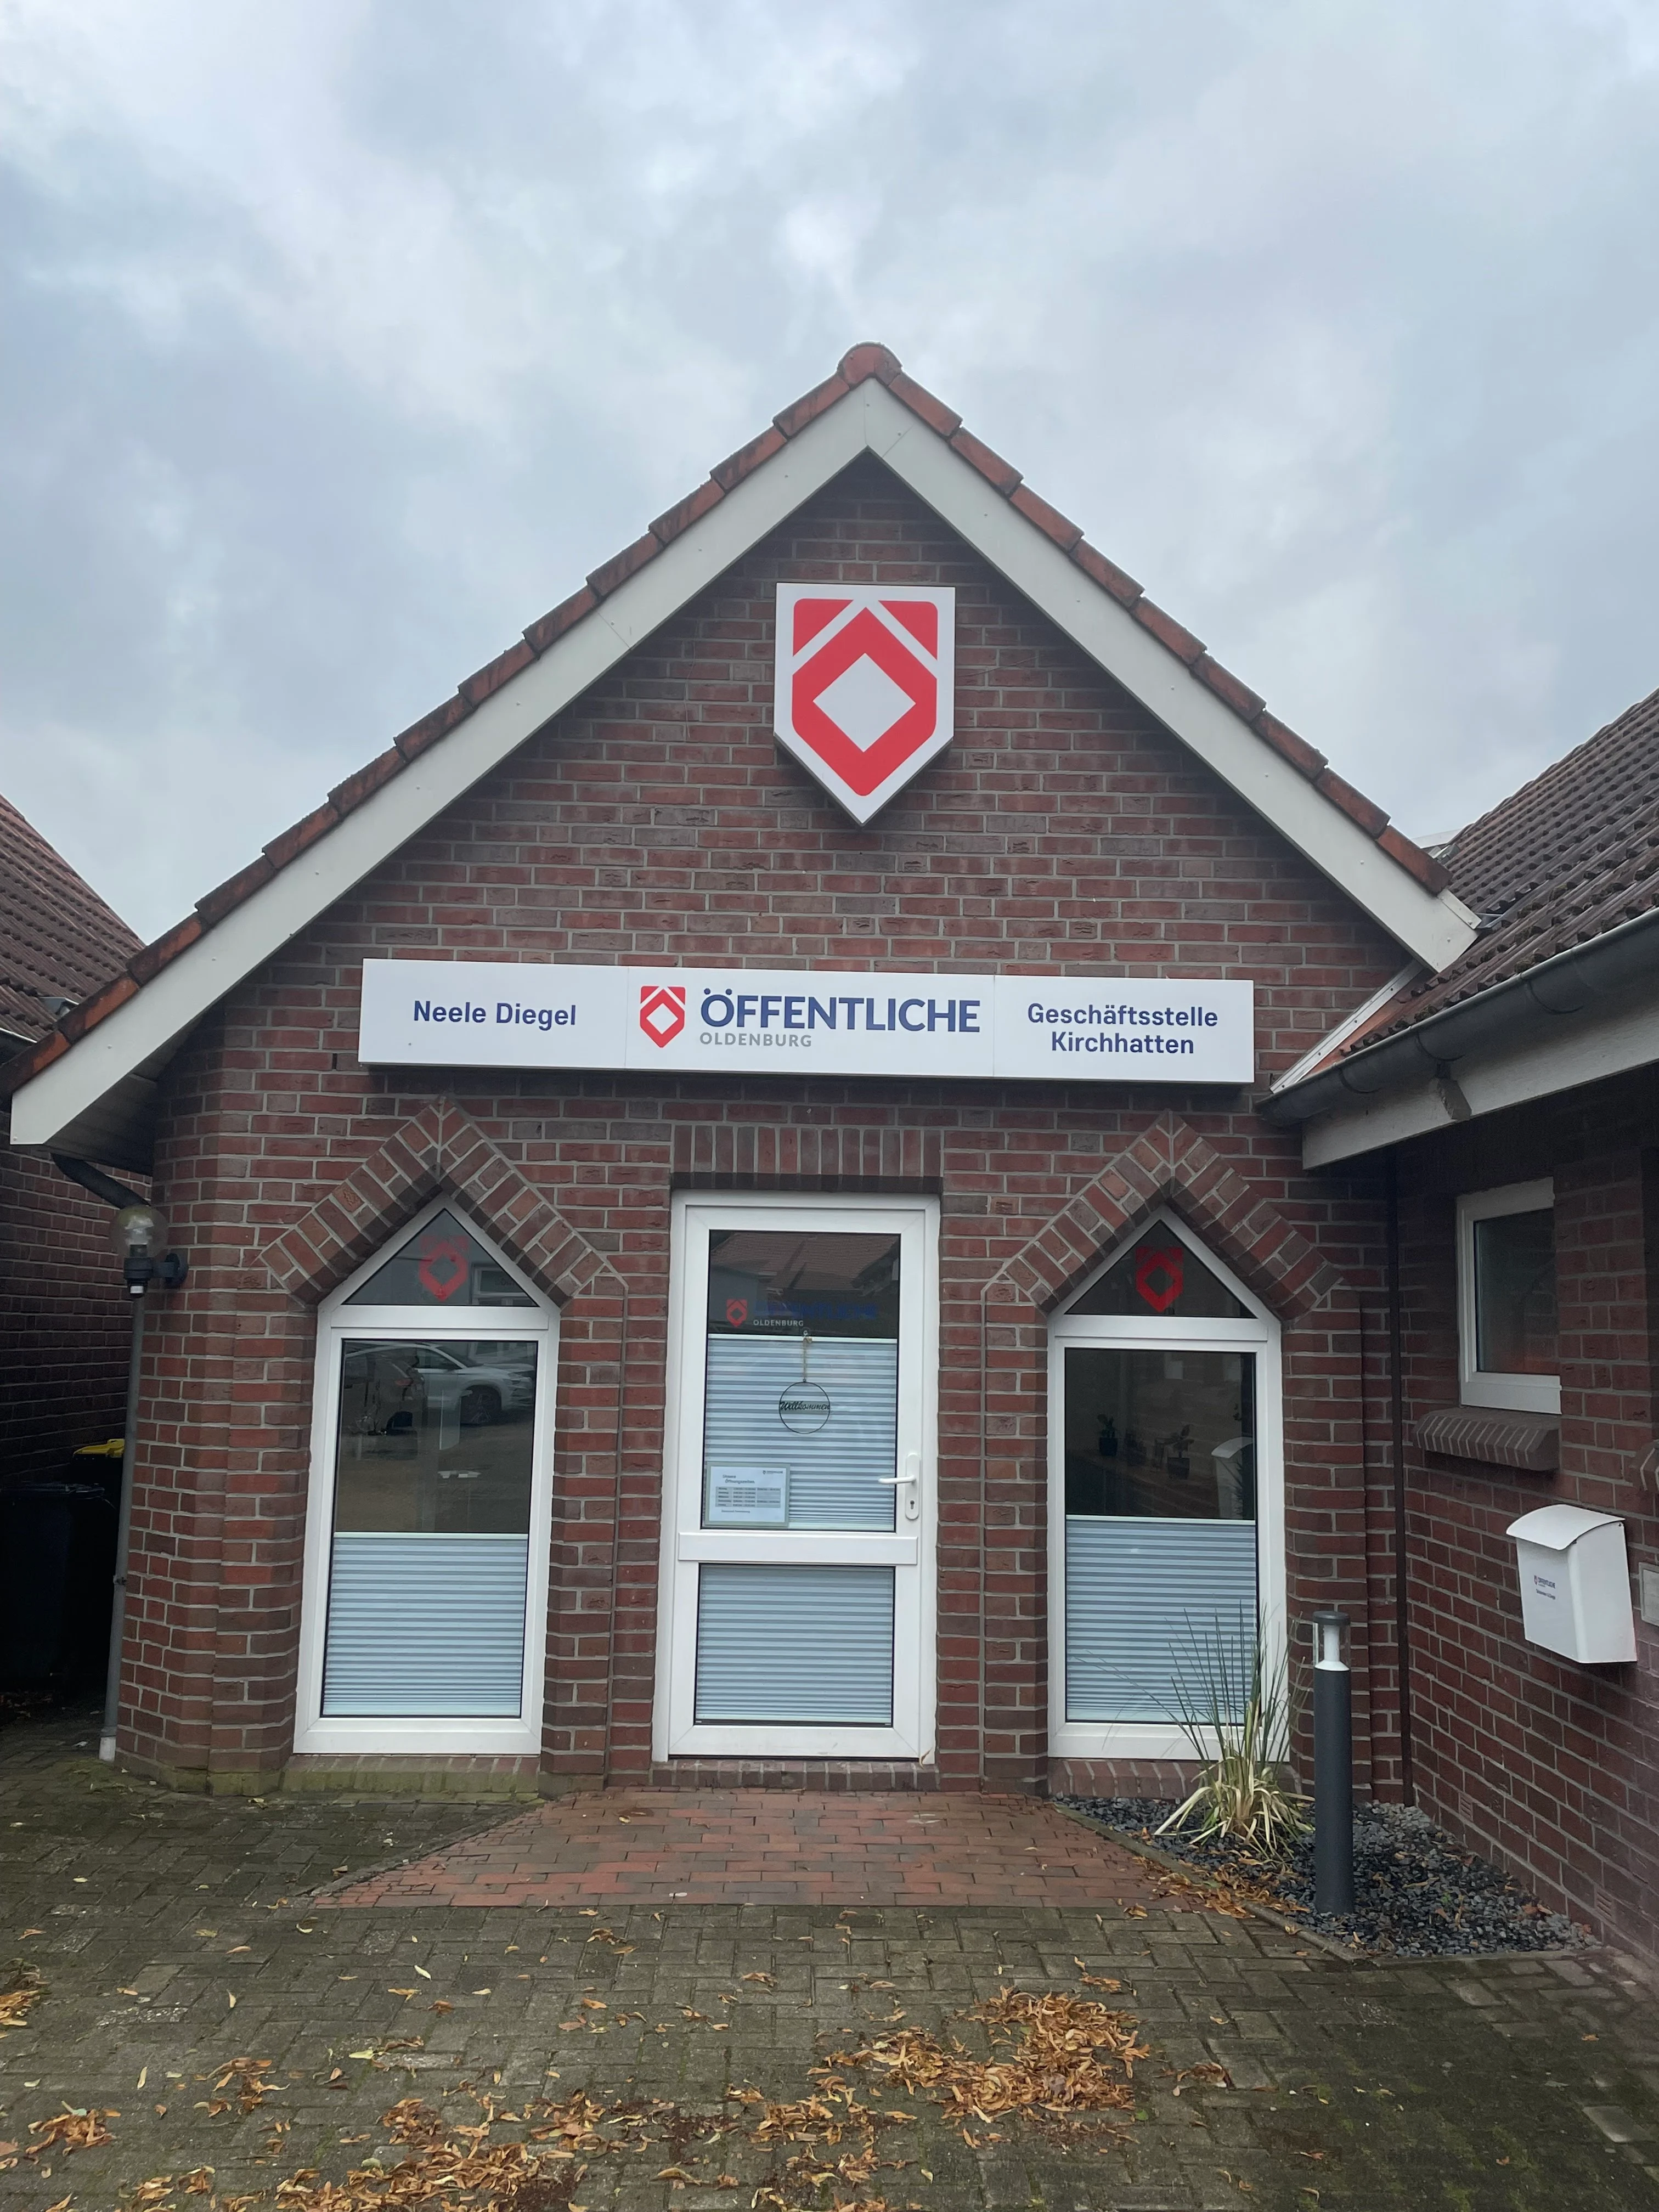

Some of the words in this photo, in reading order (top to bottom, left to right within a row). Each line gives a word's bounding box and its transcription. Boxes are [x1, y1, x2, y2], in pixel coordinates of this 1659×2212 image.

[414, 1000, 486, 1023] Neele
[496, 1003, 576, 1031] Diegel
[701, 988, 980, 1032] ÖFFENTLICHE
[1028, 1003, 1218, 1027] Geschäftsstelle
[699, 1032, 812, 1047] OLDENBURG
[1052, 1031, 1194, 1054] Kirchhatten
[753, 1299, 876, 1319] NTLICHE
[780, 1401, 830, 1410] Willkommen
